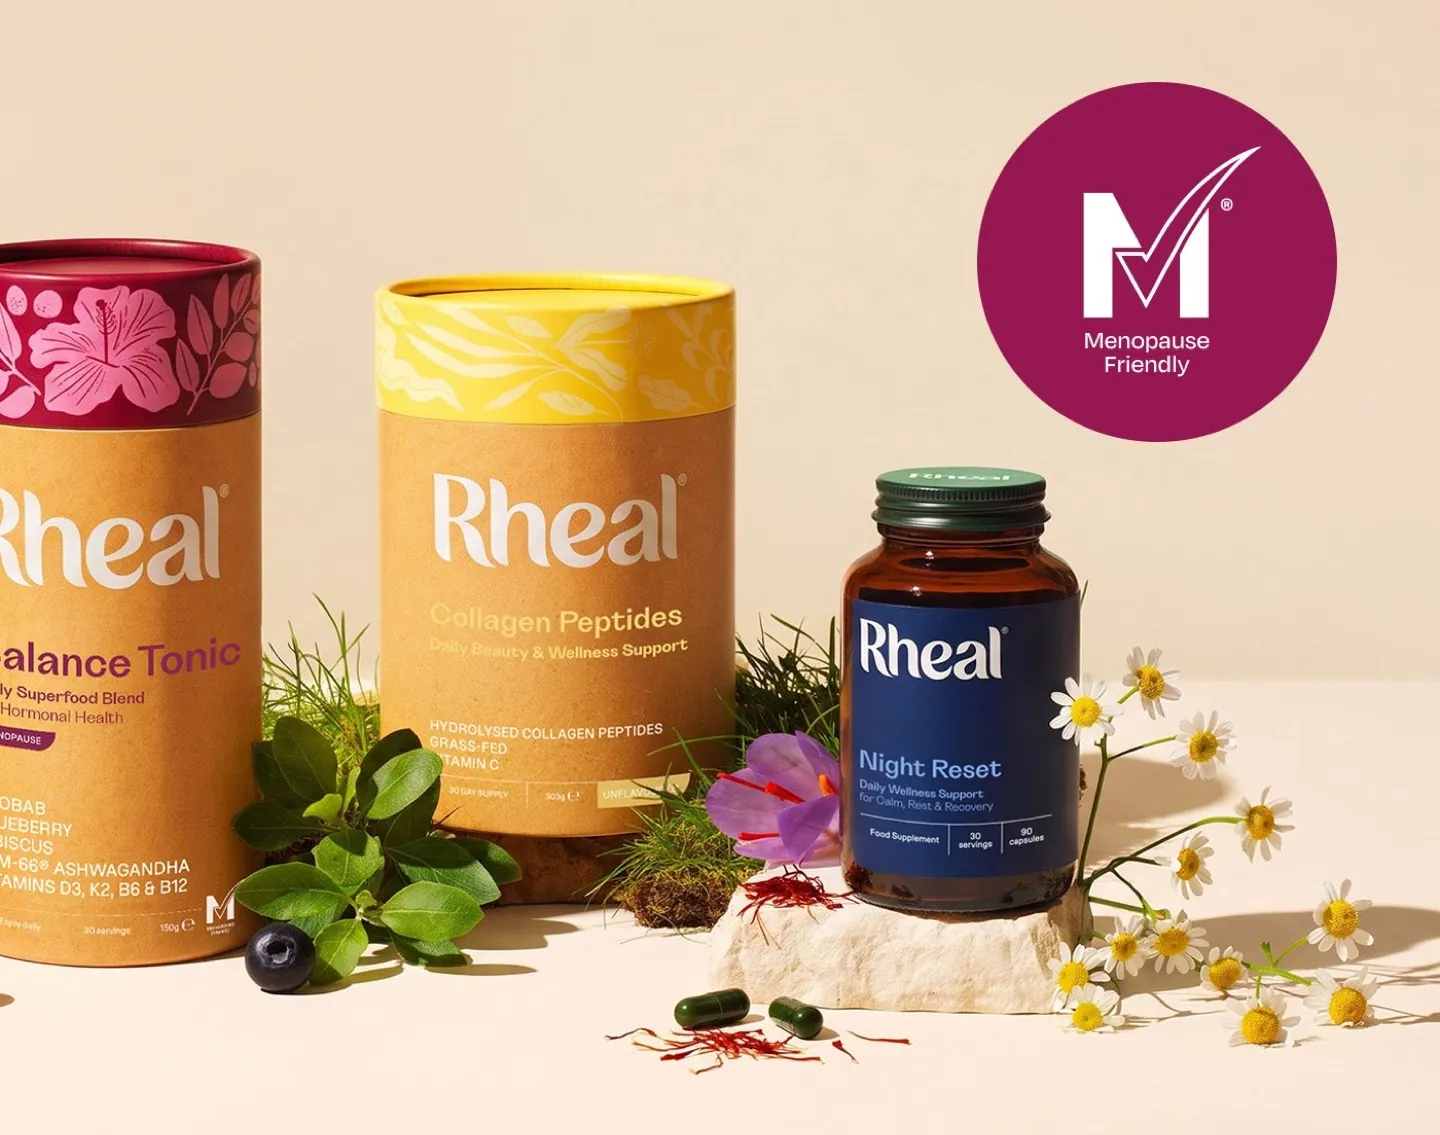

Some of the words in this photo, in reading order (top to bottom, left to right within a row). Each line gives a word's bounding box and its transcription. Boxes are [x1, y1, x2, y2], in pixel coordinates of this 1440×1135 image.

[430, 602, 551, 638] Collagen
[560, 606, 683, 639] Peptides
[138, 637, 242, 677] Tonic
[430, 636, 468, 656] Daily
[472, 643, 527, 662] Beauty
[532, 646, 545, 660] &
[548, 645, 619, 660] Wellness
[622, 638, 689, 658] Support
[16, 686, 99, 704] Superfood
[102, 691, 146, 705] Blend
[0, 702, 72, 724] Hormonal
[75, 709, 124, 725] Health
[430, 719, 519, 739] HYDROLYSED
[522, 727, 595, 741] COLLAGEN
[598, 722, 664, 740] PEPTIDES
[430, 735, 508, 755] GRASS-FED
[440, 753, 487, 770] TAMIN
[489, 758, 501, 772] C
[860, 750, 926, 780] Night
[932, 759, 1002, 779] Reset
[478, 790, 509, 800] SUPPLY
[860, 779, 886, 794] Daily
[888, 784, 936, 798] Wellness
[938, 788, 984, 801] Support
[860, 792, 874, 803] for
[876, 796, 906, 809] Calm,
[908, 799, 932, 812] Rest
[934, 801, 943, 812] &
[945, 802, 994, 813] Recovery
[870, 828, 891, 839] Food
[892, 832, 940, 844] Supplement
[970, 832, 981, 841] 30
[1009, 834, 1045, 846] capsules
[1021, 827, 1033, 836] 90
[959, 841, 993, 849] servings
[53, 858, 190, 878] ASHWAGANDHA
[60, 880, 85, 898] D3,
[89, 883, 114, 899] K2,
[118, 882, 139, 897] B6
[144, 881, 156, 896] &
[160, 877, 188, 895] B12
[160, 923, 180, 933] 150g
